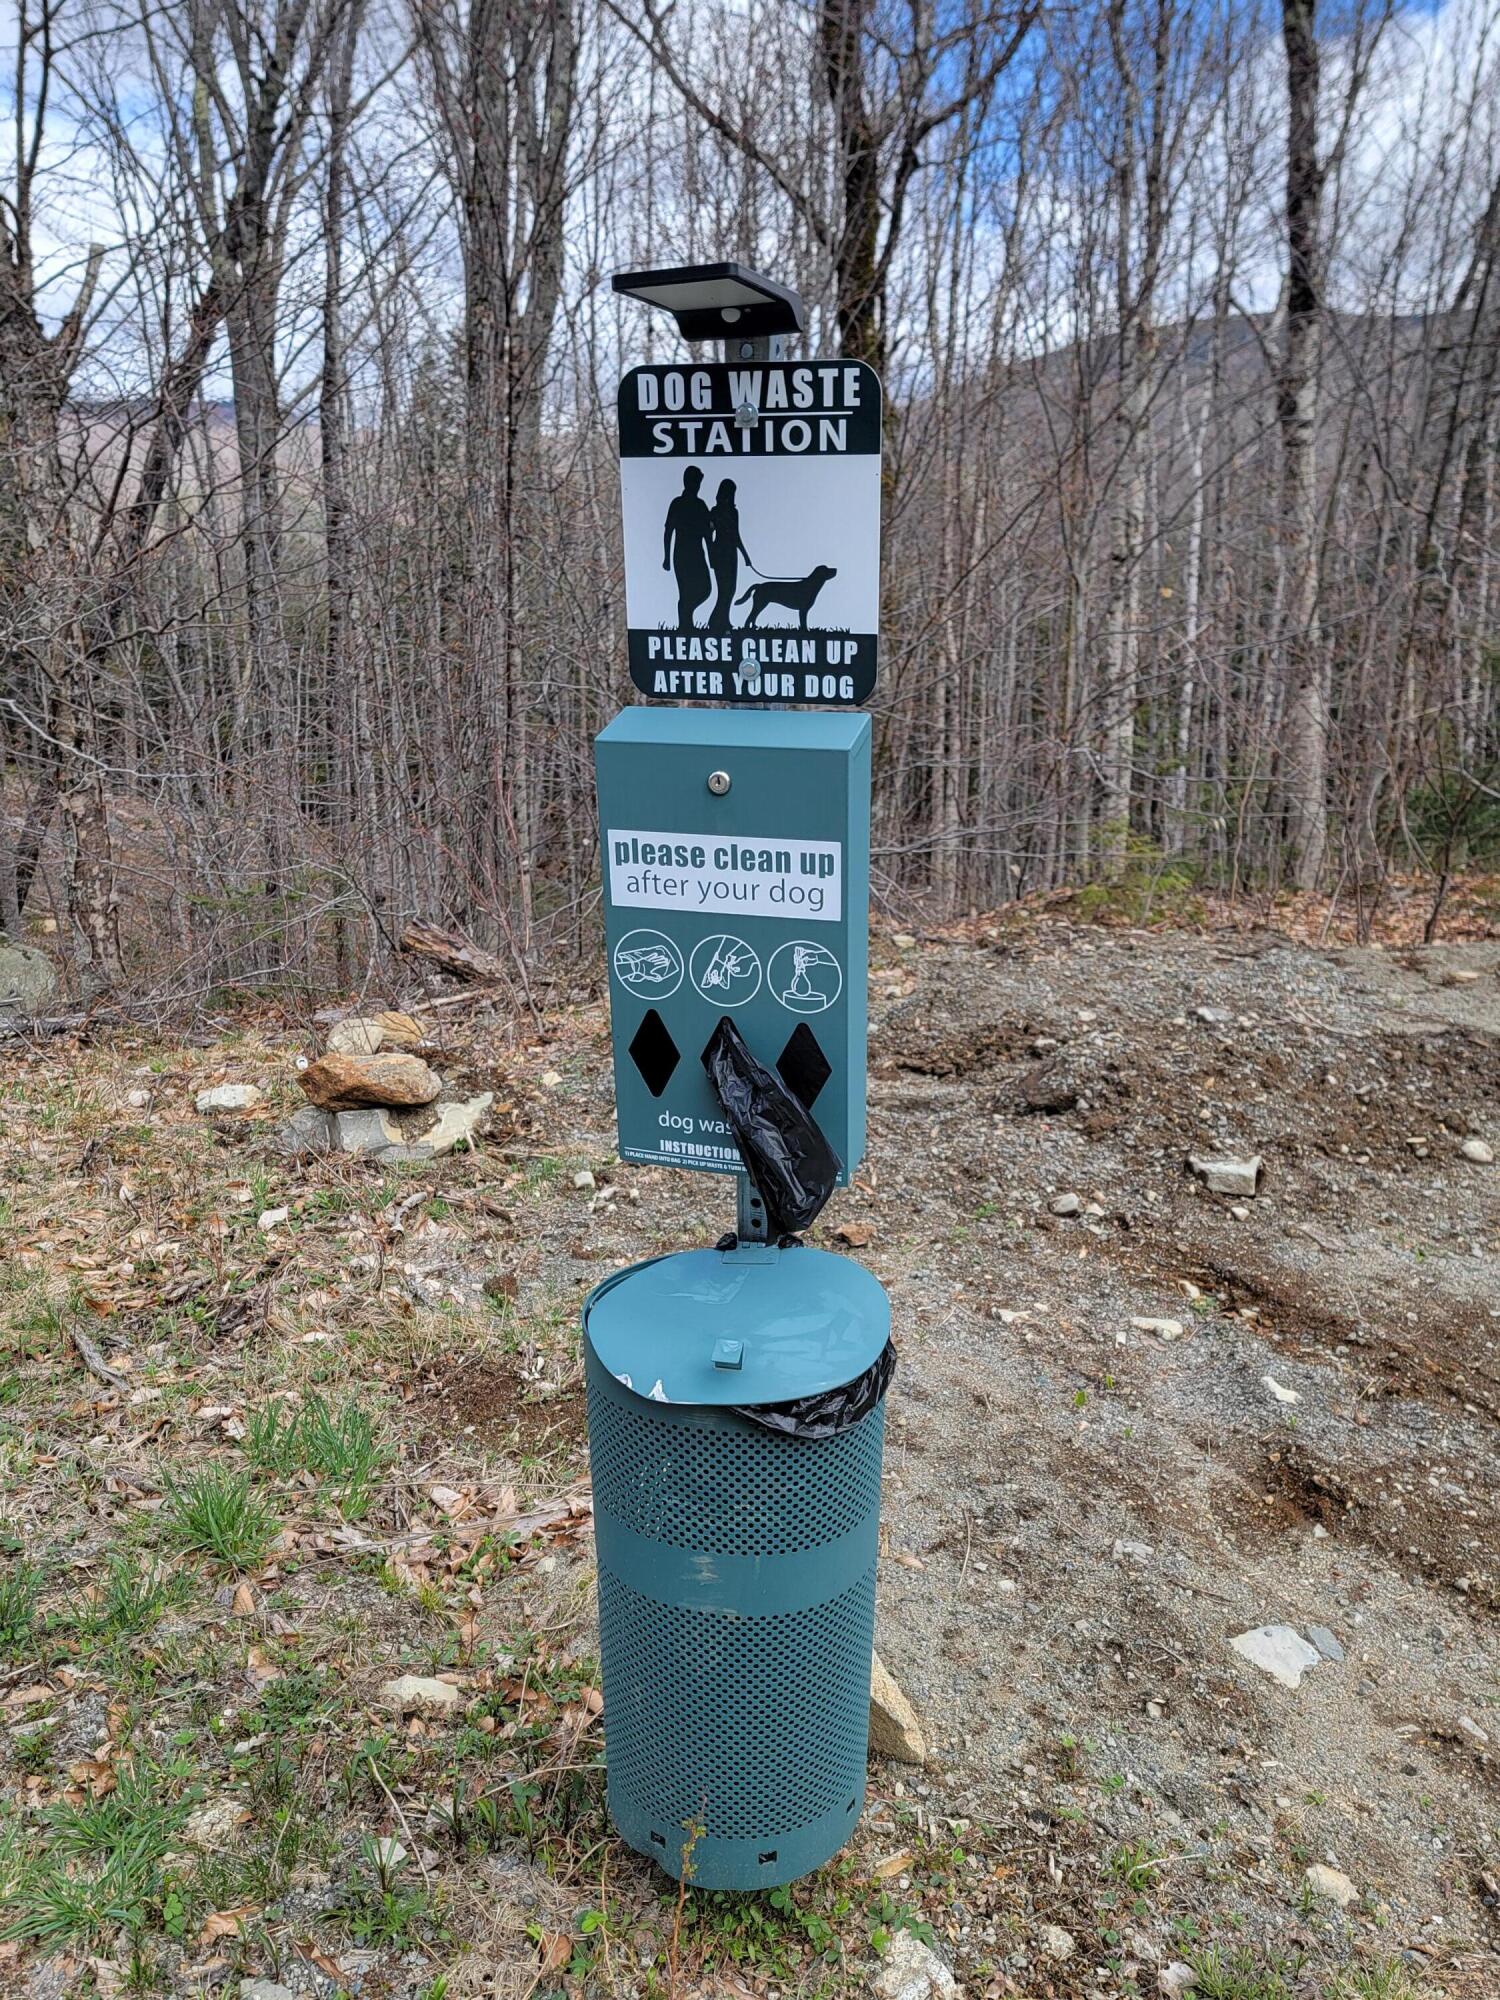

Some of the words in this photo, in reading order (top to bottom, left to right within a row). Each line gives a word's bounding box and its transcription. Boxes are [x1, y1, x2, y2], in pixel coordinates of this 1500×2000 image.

[637, 372, 712, 411] DOG
[728, 367, 861, 410] WASTE
[652, 419, 848, 454] STATION
[648, 636, 732, 662] PLEASE
[742, 637, 816, 664] CLEAN
[827, 640, 858, 665] UP
[654, 671, 723, 695] AFTER
[732, 672, 795, 697] YOUR
[805, 675, 854, 699] DOG
[614, 838, 705, 868] please
[714, 844, 791, 873] clean
[801, 852, 834, 878] up
[627, 869, 689, 896] after
[697, 880, 760, 904] your
[769, 878, 825, 911] dog
[658, 1110, 694, 1134] dog
[698, 1119, 733, 1135] was
[660, 1139, 743, 1161] INSTRUCTION
